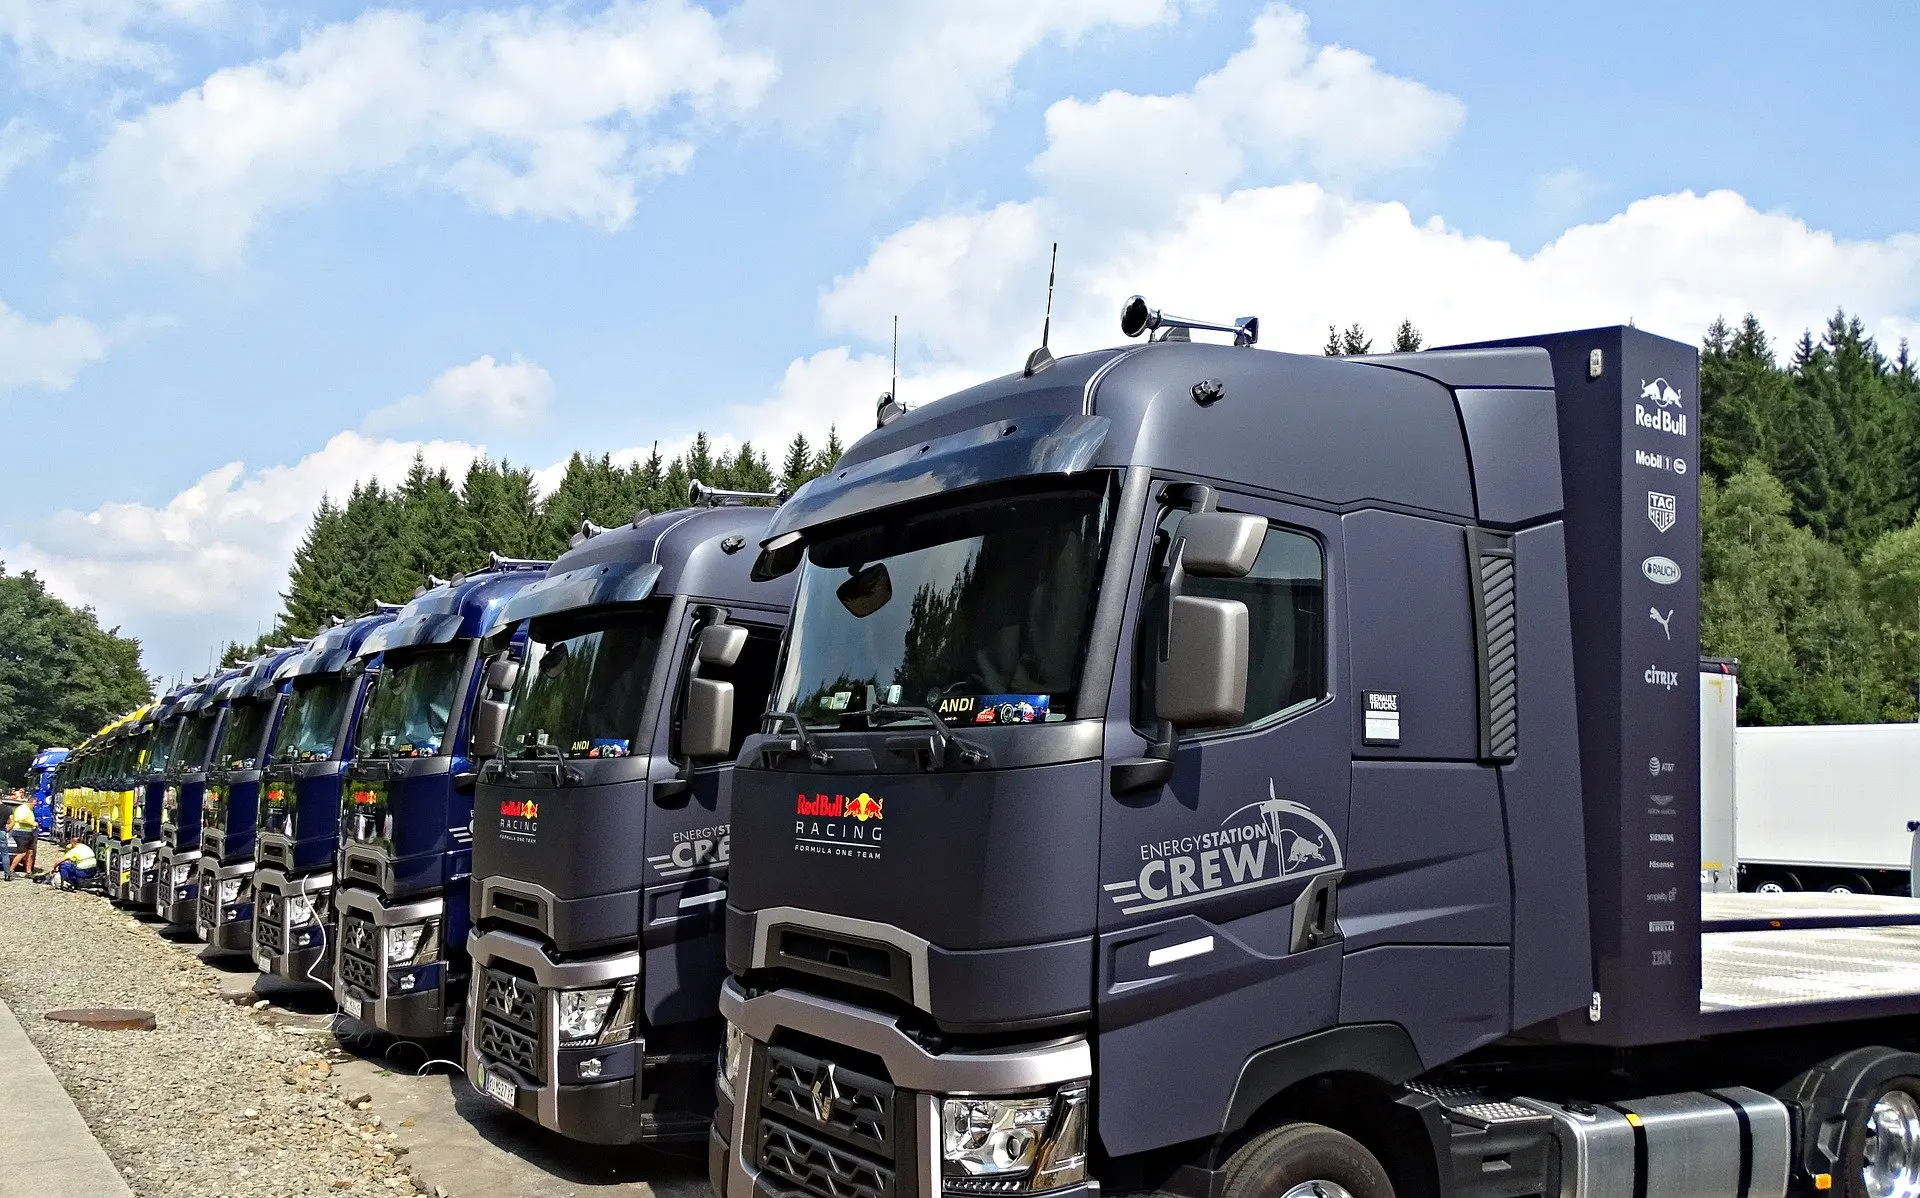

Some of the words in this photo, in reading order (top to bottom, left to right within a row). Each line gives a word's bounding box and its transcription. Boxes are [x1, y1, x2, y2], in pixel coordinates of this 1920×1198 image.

[1635, 449, 1662, 469] Mobil
[1650, 495, 1673, 510] TAG
[1650, 508, 1674, 529] HEUER
[1652, 563, 1677, 577] RAUCH
[938, 697, 975, 713] ANDI
[1369, 693, 1397, 704] RENAULT
[1370, 701, 1398, 711] TRUCKS
[571, 740, 590, 751] ANDI
[500, 818, 538, 832] RACING
[795, 821, 882, 841] RACING
[673, 824, 731, 843] ENERGYST
[672, 835, 731, 868] CRE
[794, 844, 832, 855] FORMULA
[835, 848, 853, 857] ONE
[856, 850, 881, 860] TEAM
[1139, 840, 1268, 901] CREW
